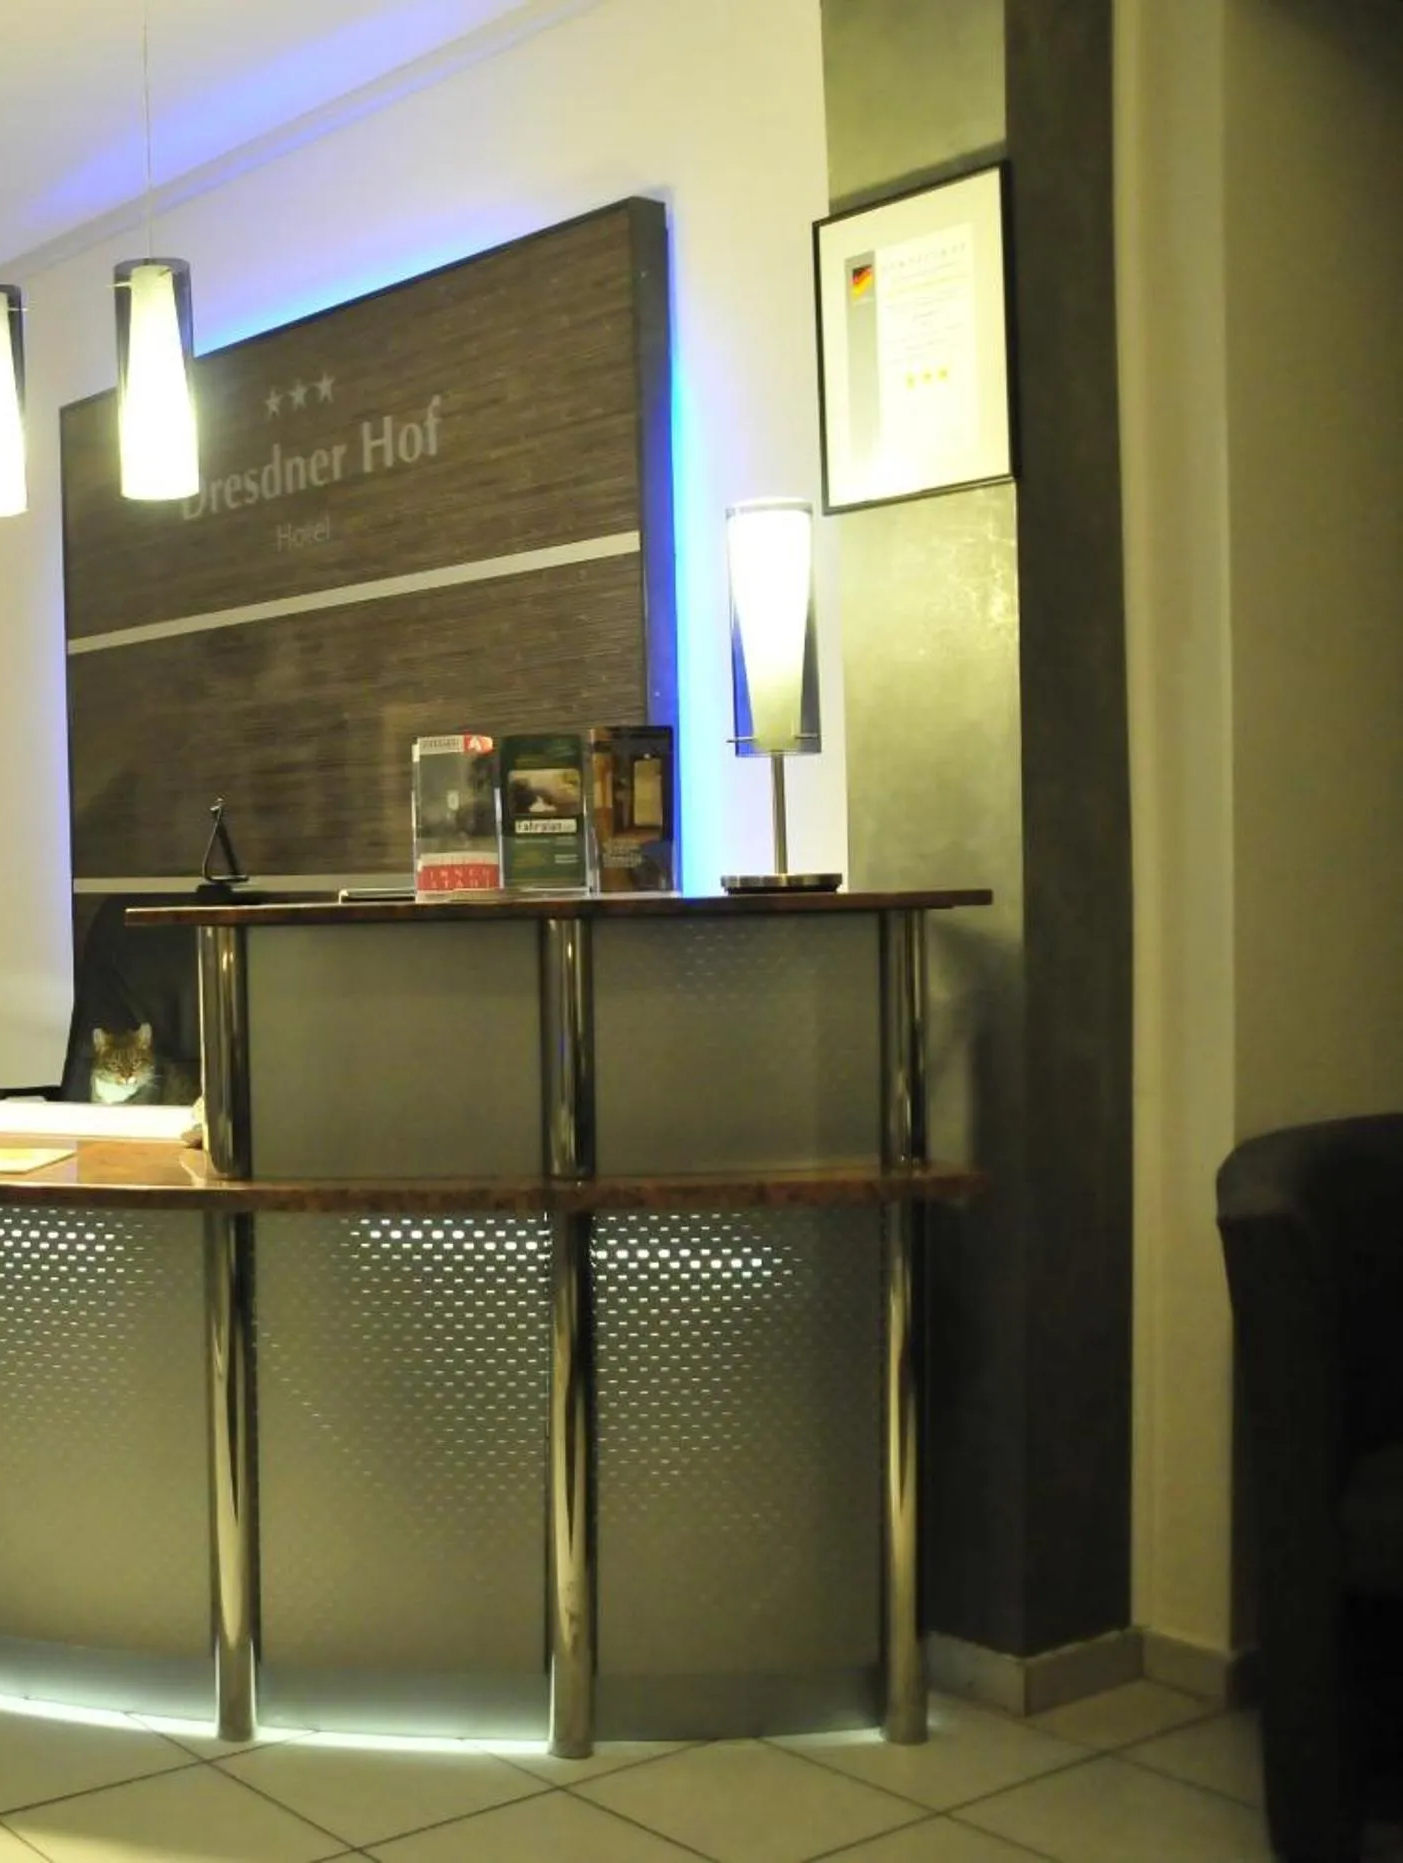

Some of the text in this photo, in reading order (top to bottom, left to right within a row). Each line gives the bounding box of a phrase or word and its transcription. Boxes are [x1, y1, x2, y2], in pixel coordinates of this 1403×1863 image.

[182, 394, 442, 520] Dresdner Hof
[275, 508, 331, 553] Hotel
